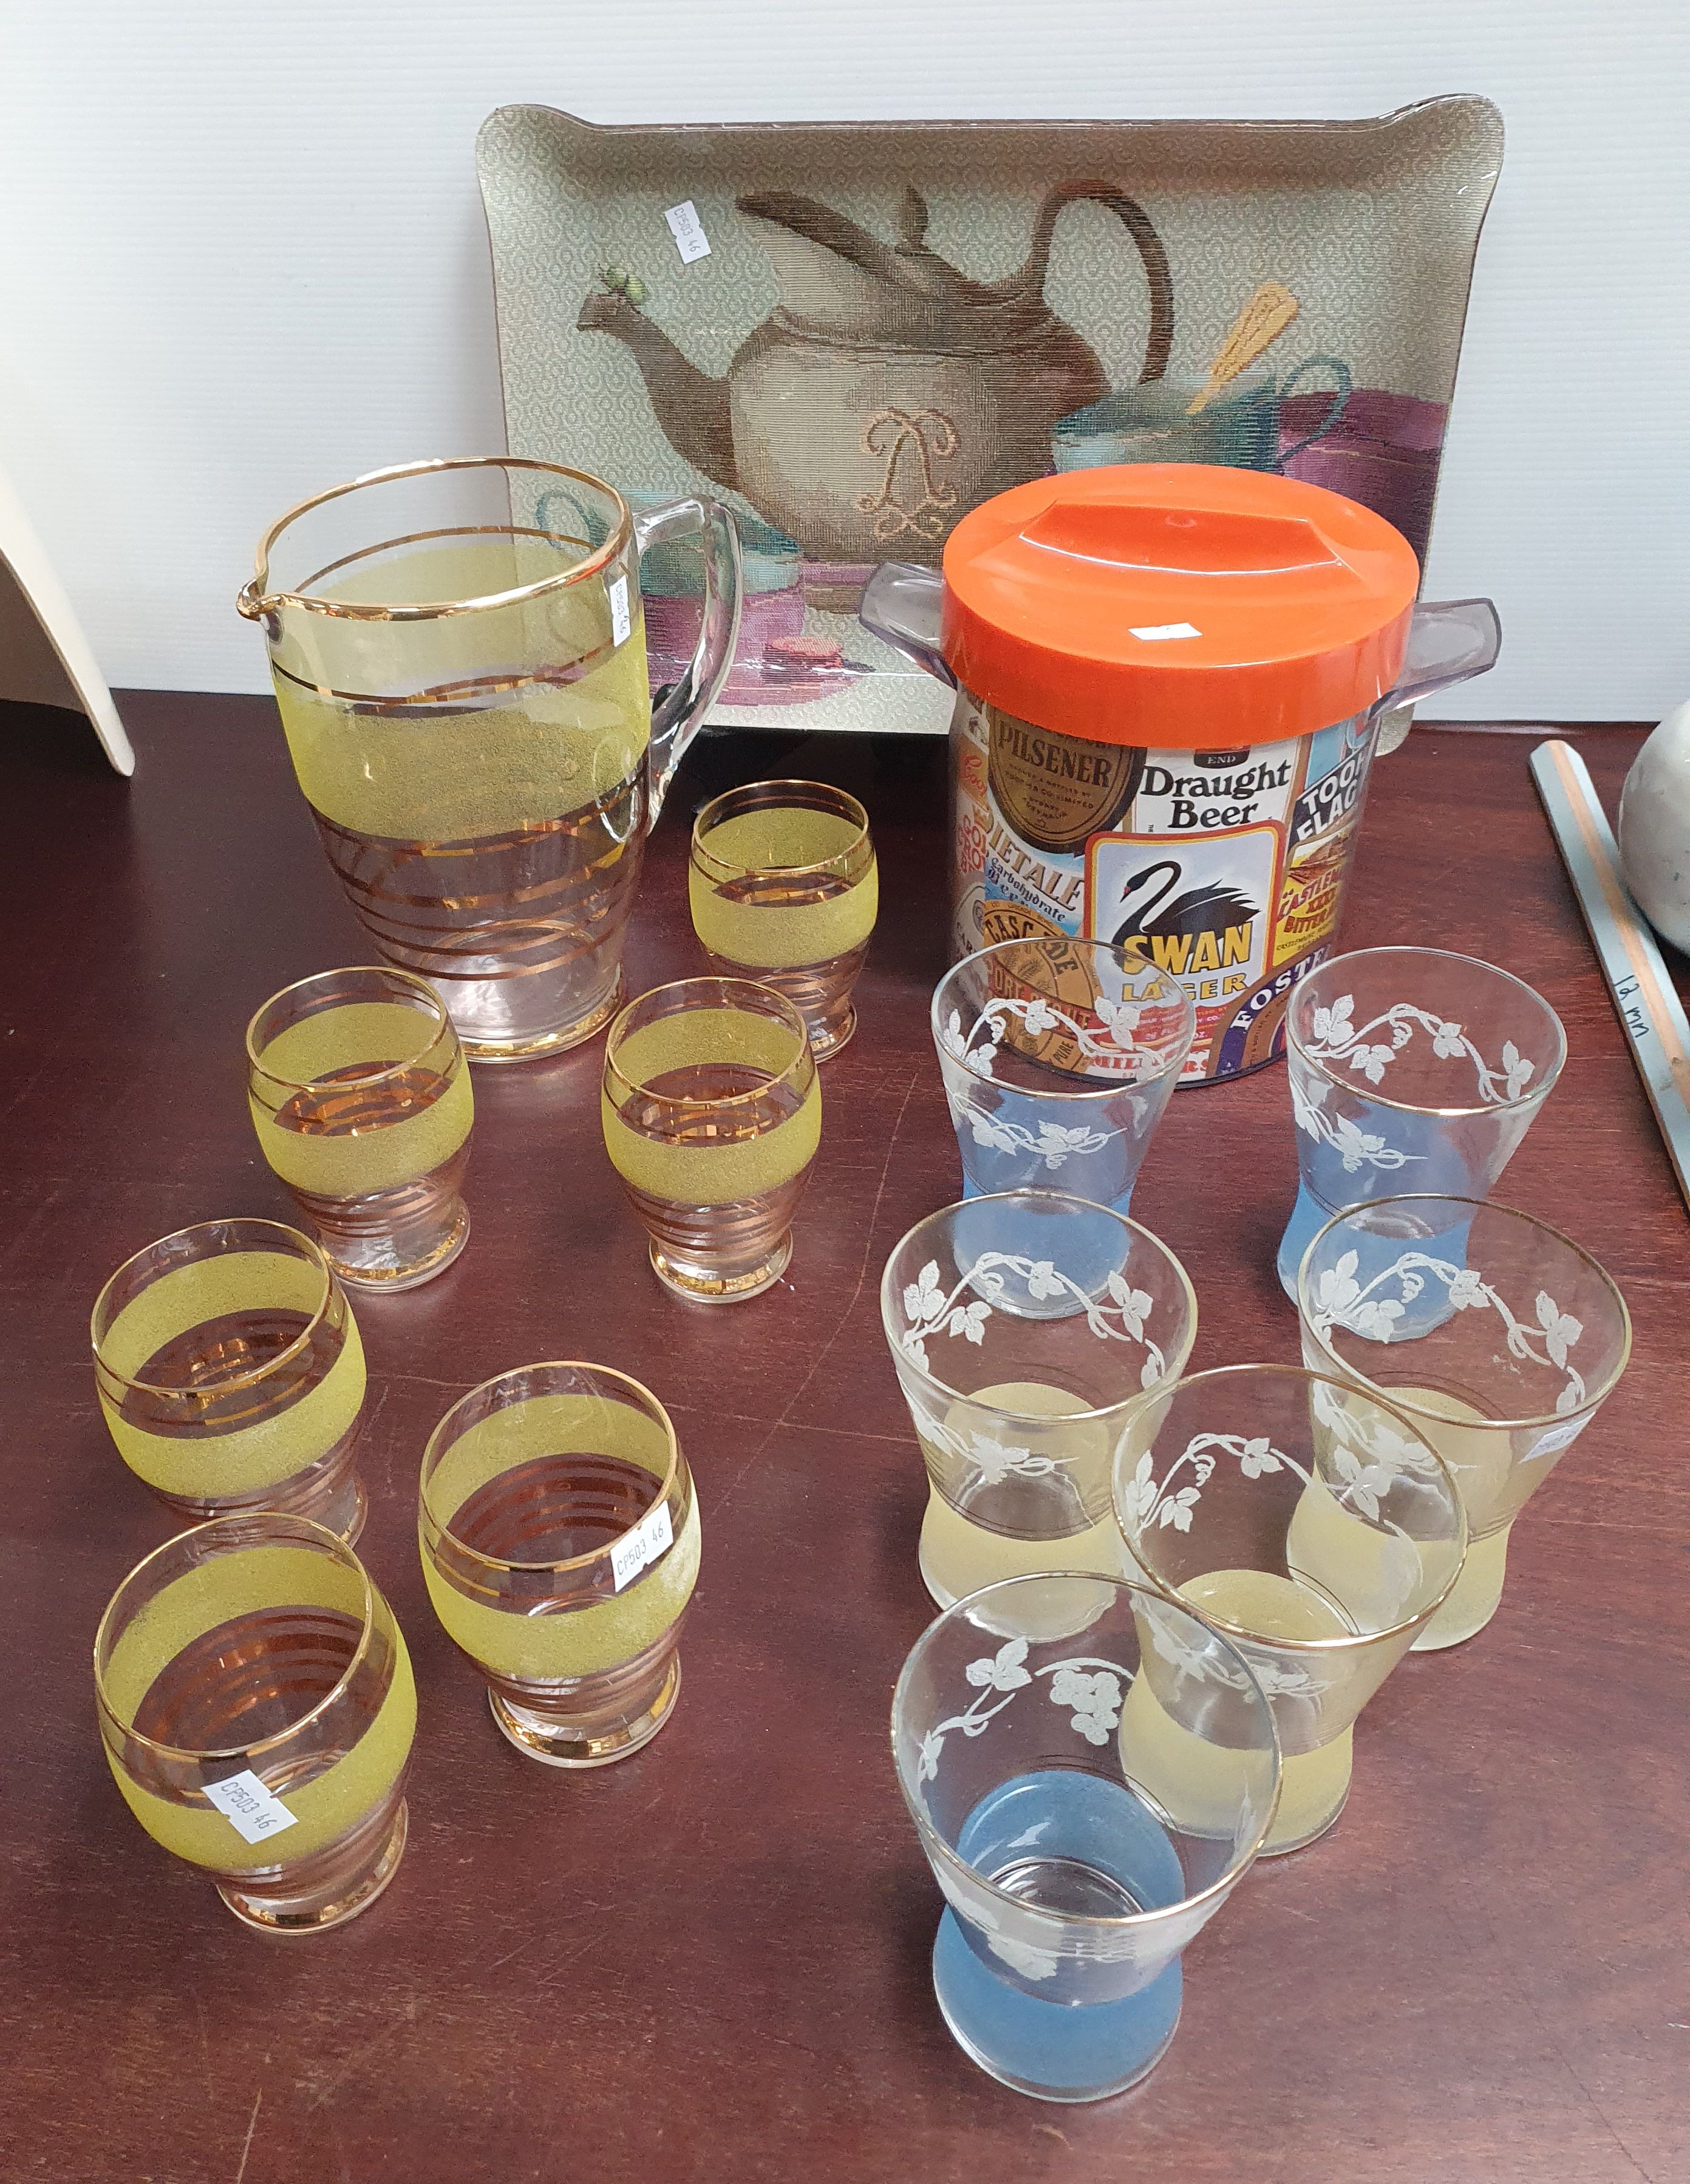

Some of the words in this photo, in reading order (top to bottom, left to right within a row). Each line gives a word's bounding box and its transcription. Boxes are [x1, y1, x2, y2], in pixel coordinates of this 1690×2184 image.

[688, 239, 701, 253] 46
[999, 720, 1109, 788] PILSENER
[1207, 755, 1236, 764] END
[1140, 759, 1292, 800] Draught
[1167, 800, 1259, 829] Beer
[1123, 920, 1253, 975] SWAN
[1122, 972, 1249, 1002] LAGER
[1052, 1040, 1074, 1065] PURE
[616, 1538, 647, 1576] CP503
[652, 1520, 664, 1542] 46
[220, 1781, 261, 1814] CP503
[253, 1812, 278, 1829] 46
